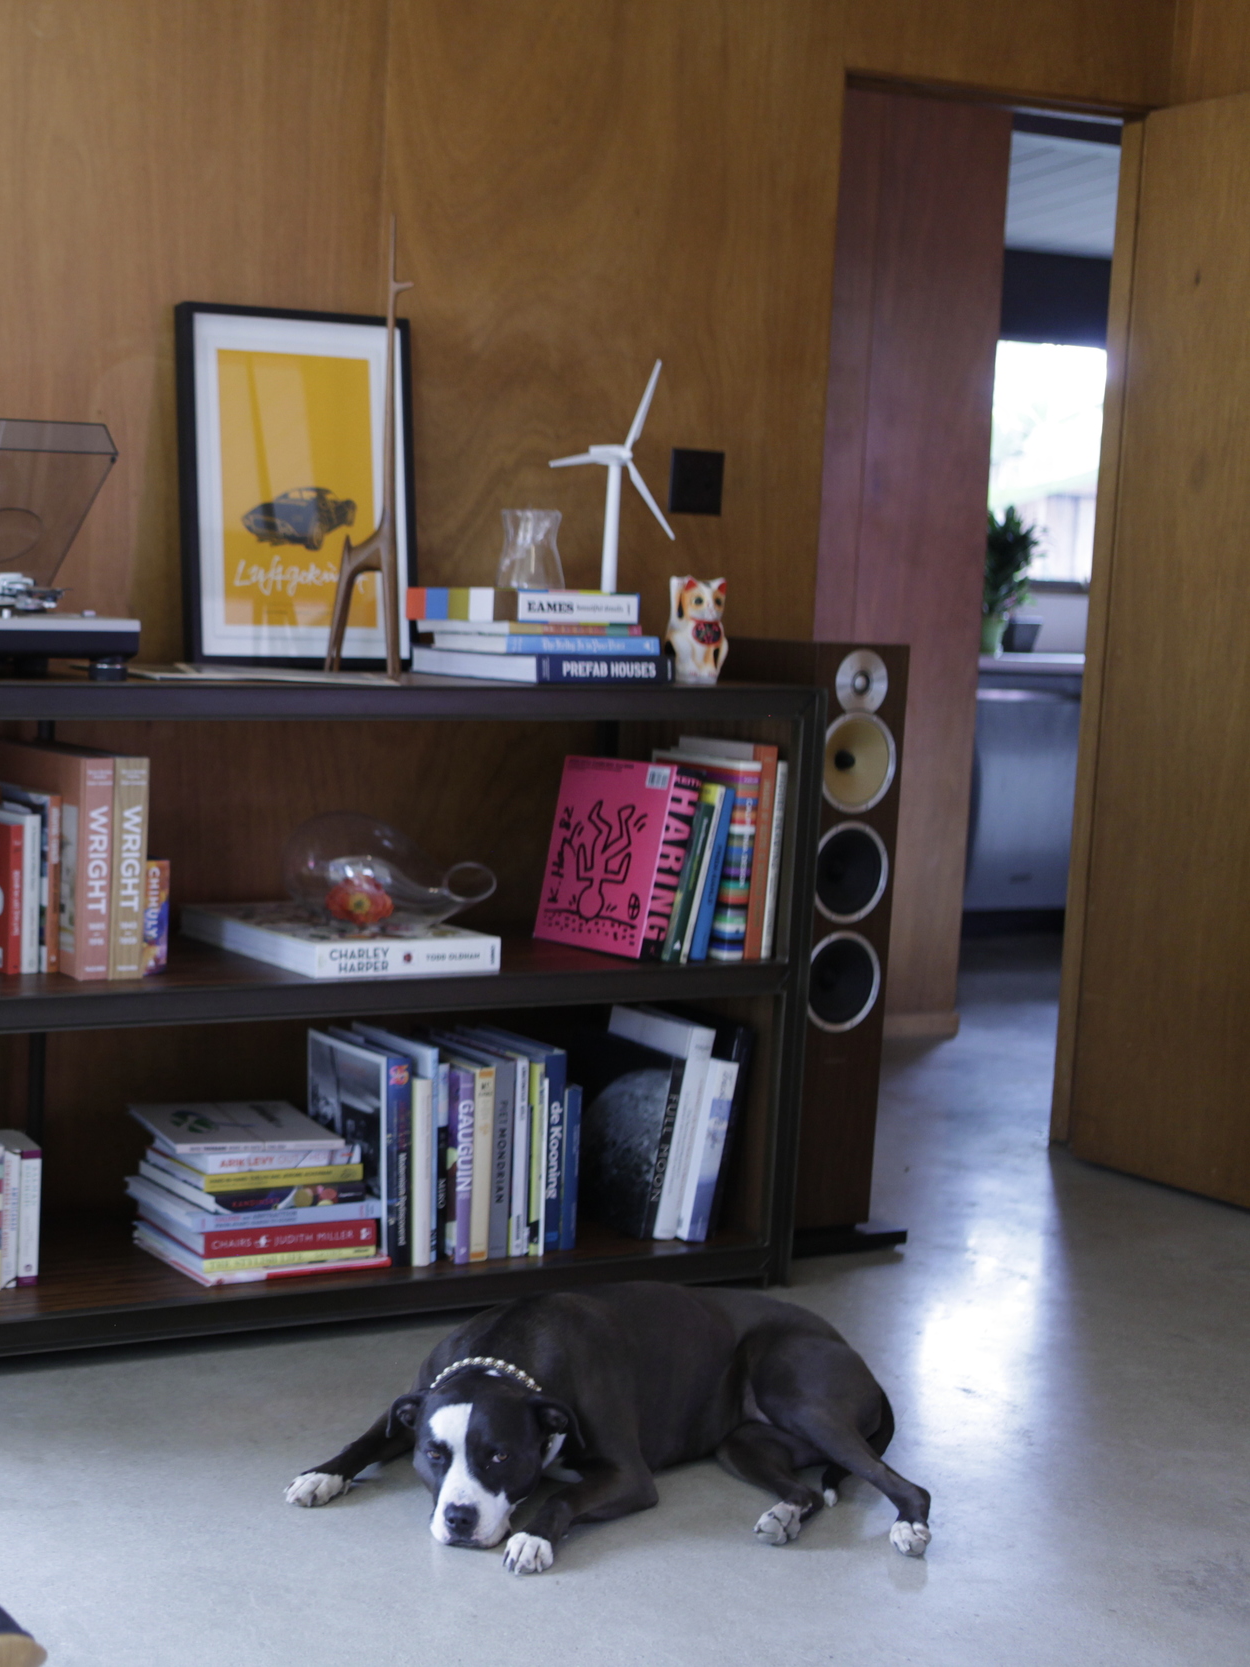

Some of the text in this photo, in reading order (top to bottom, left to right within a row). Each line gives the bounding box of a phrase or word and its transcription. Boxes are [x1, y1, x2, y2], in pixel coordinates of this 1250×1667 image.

[233, 555, 368, 597] Luftgeküt
[527, 601, 574, 613] EAMES
[562, 660, 609, 678] PREFAB
[611, 661, 657, 678] HOUSES
[87, 805, 109, 915] WRIGHT
[119, 805, 143, 912] WRIGHT
[644, 787, 701, 942] HARING
[146, 866, 161, 938] CHIHULY
[329, 947, 390, 961] CHARLEY
[338, 960, 389, 974] HARPER
[448, 952, 481, 961] OLDHAM
[659, 1092, 678, 1136] FULL
[219, 1157, 245, 1168] ARIK
[248, 1156, 275, 1166] LEVY
[455, 1099, 475, 1192] GAUGUIN
[494, 1100, 509, 1204] PIET MONDRIAN
[545, 1101, 563, 1200] de Kooning
[210, 1229, 354, 1250] CHAIRS JUDITH MILLER
